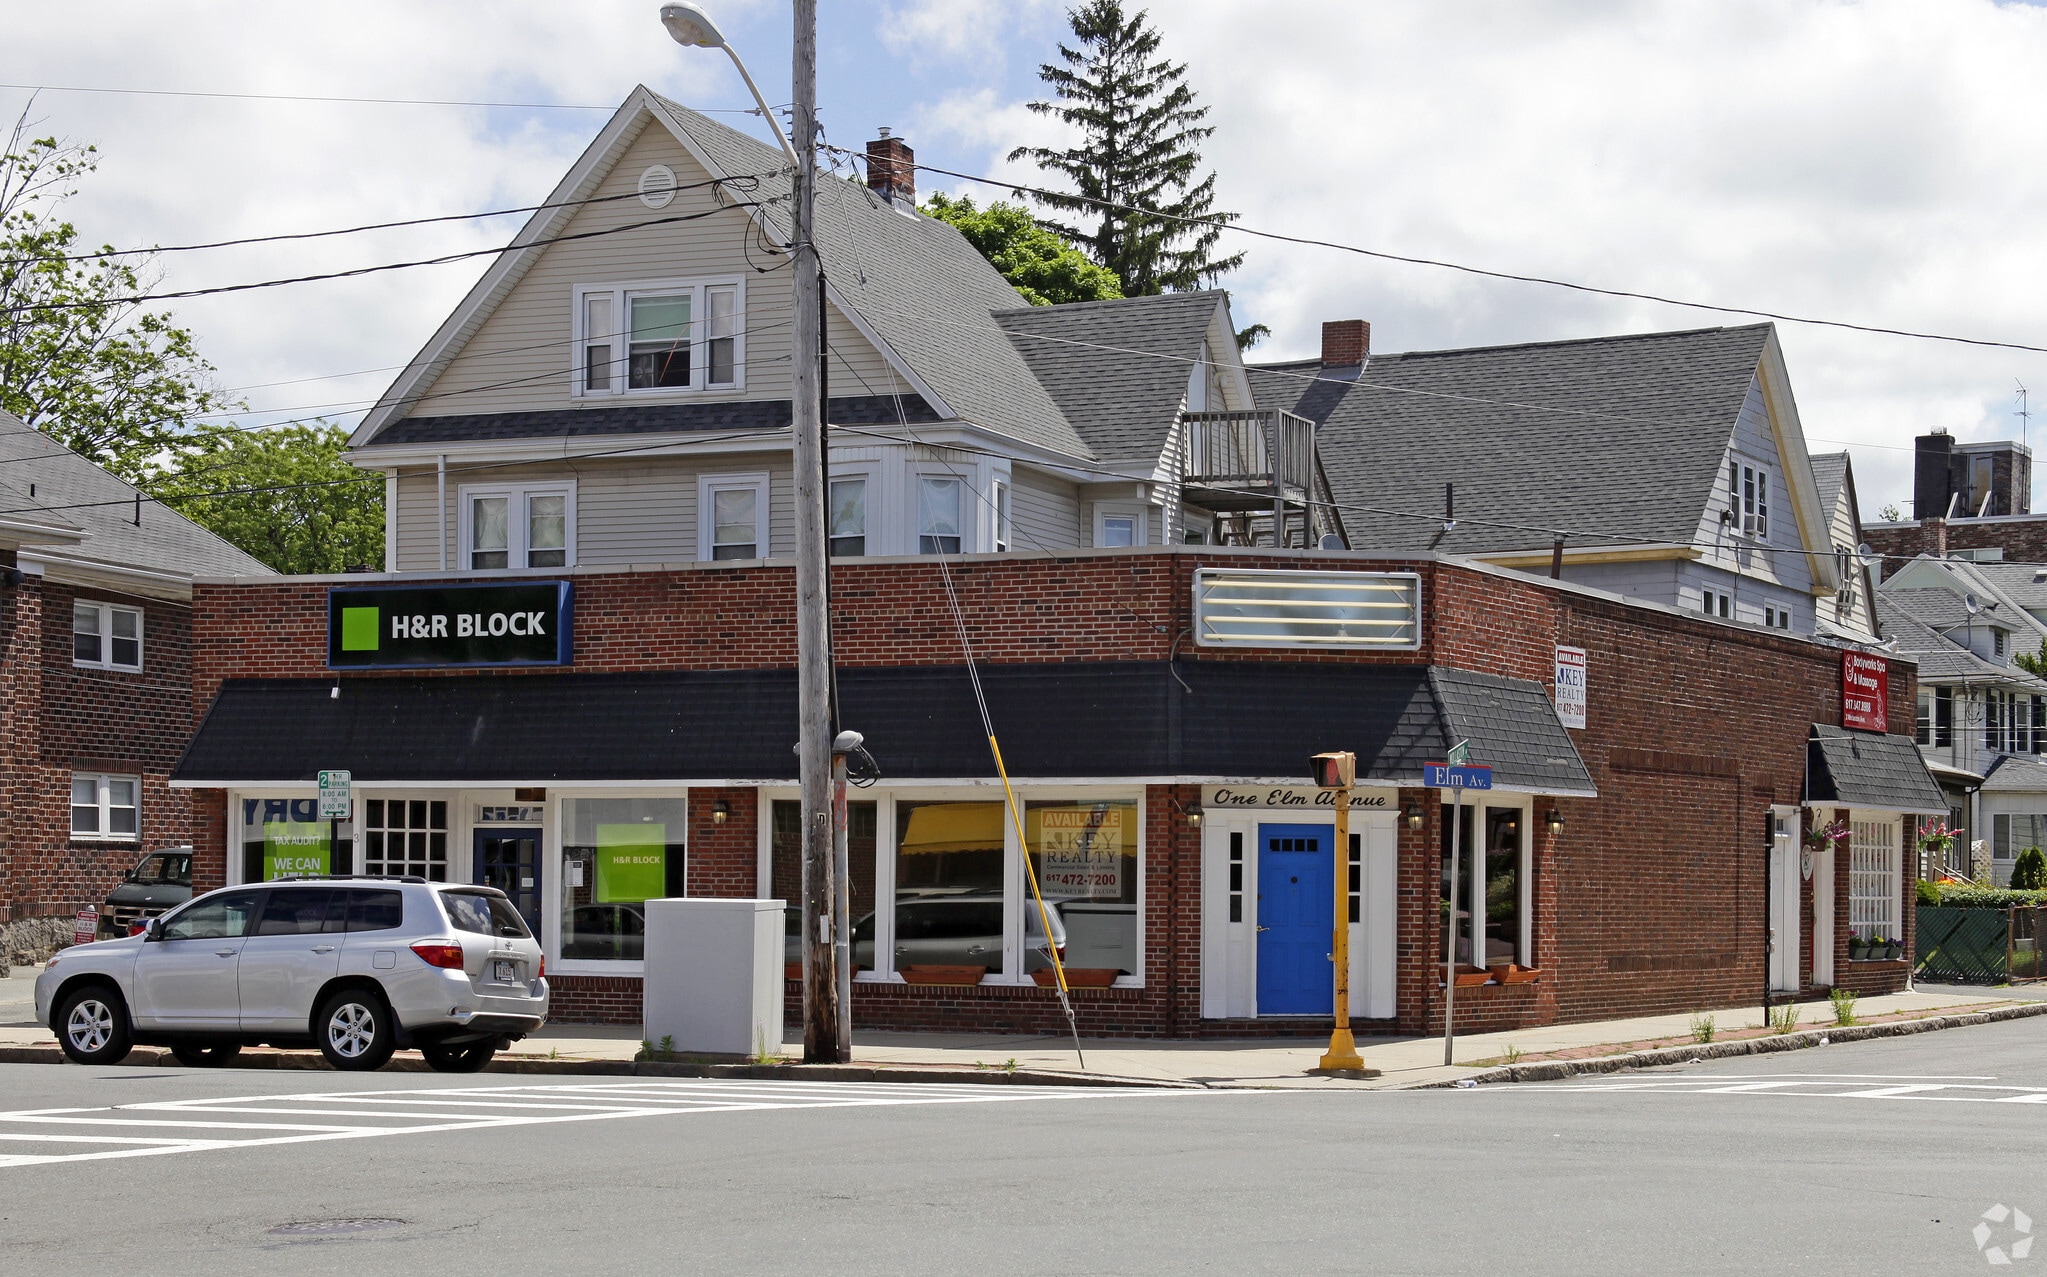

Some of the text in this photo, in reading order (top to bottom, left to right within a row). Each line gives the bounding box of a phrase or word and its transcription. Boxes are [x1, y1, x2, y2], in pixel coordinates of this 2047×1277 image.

[392, 611, 546, 639] H&R BLOCK
[1558, 652, 1584, 664] AVAILABLE
[1853, 655, 1885, 673] Bodyworks Spa
[1565, 668, 1584, 687] KEY
[1858, 674, 1877, 691] Massage
[1557, 687, 1584, 700] REALTY
[1563, 702, 1584, 716] 472-7200
[320, 774, 327, 787] 2
[1435, 767, 1487, 787] Elm Av.
[1213, 788, 1386, 807] One Elm Avnue
[1044, 812, 1119, 826] AVAILABLE
[273, 836, 320, 846] TAX AUDIT?
[353, 833, 360, 844] 3
[1067, 831, 1116, 850] KEY
[613, 856, 661, 864] H&R BLOCK
[1047, 850, 1116, 863] REALTY
[273, 857, 320, 870] WE CAN
[1046, 873, 1116, 886] 617 472-7200
